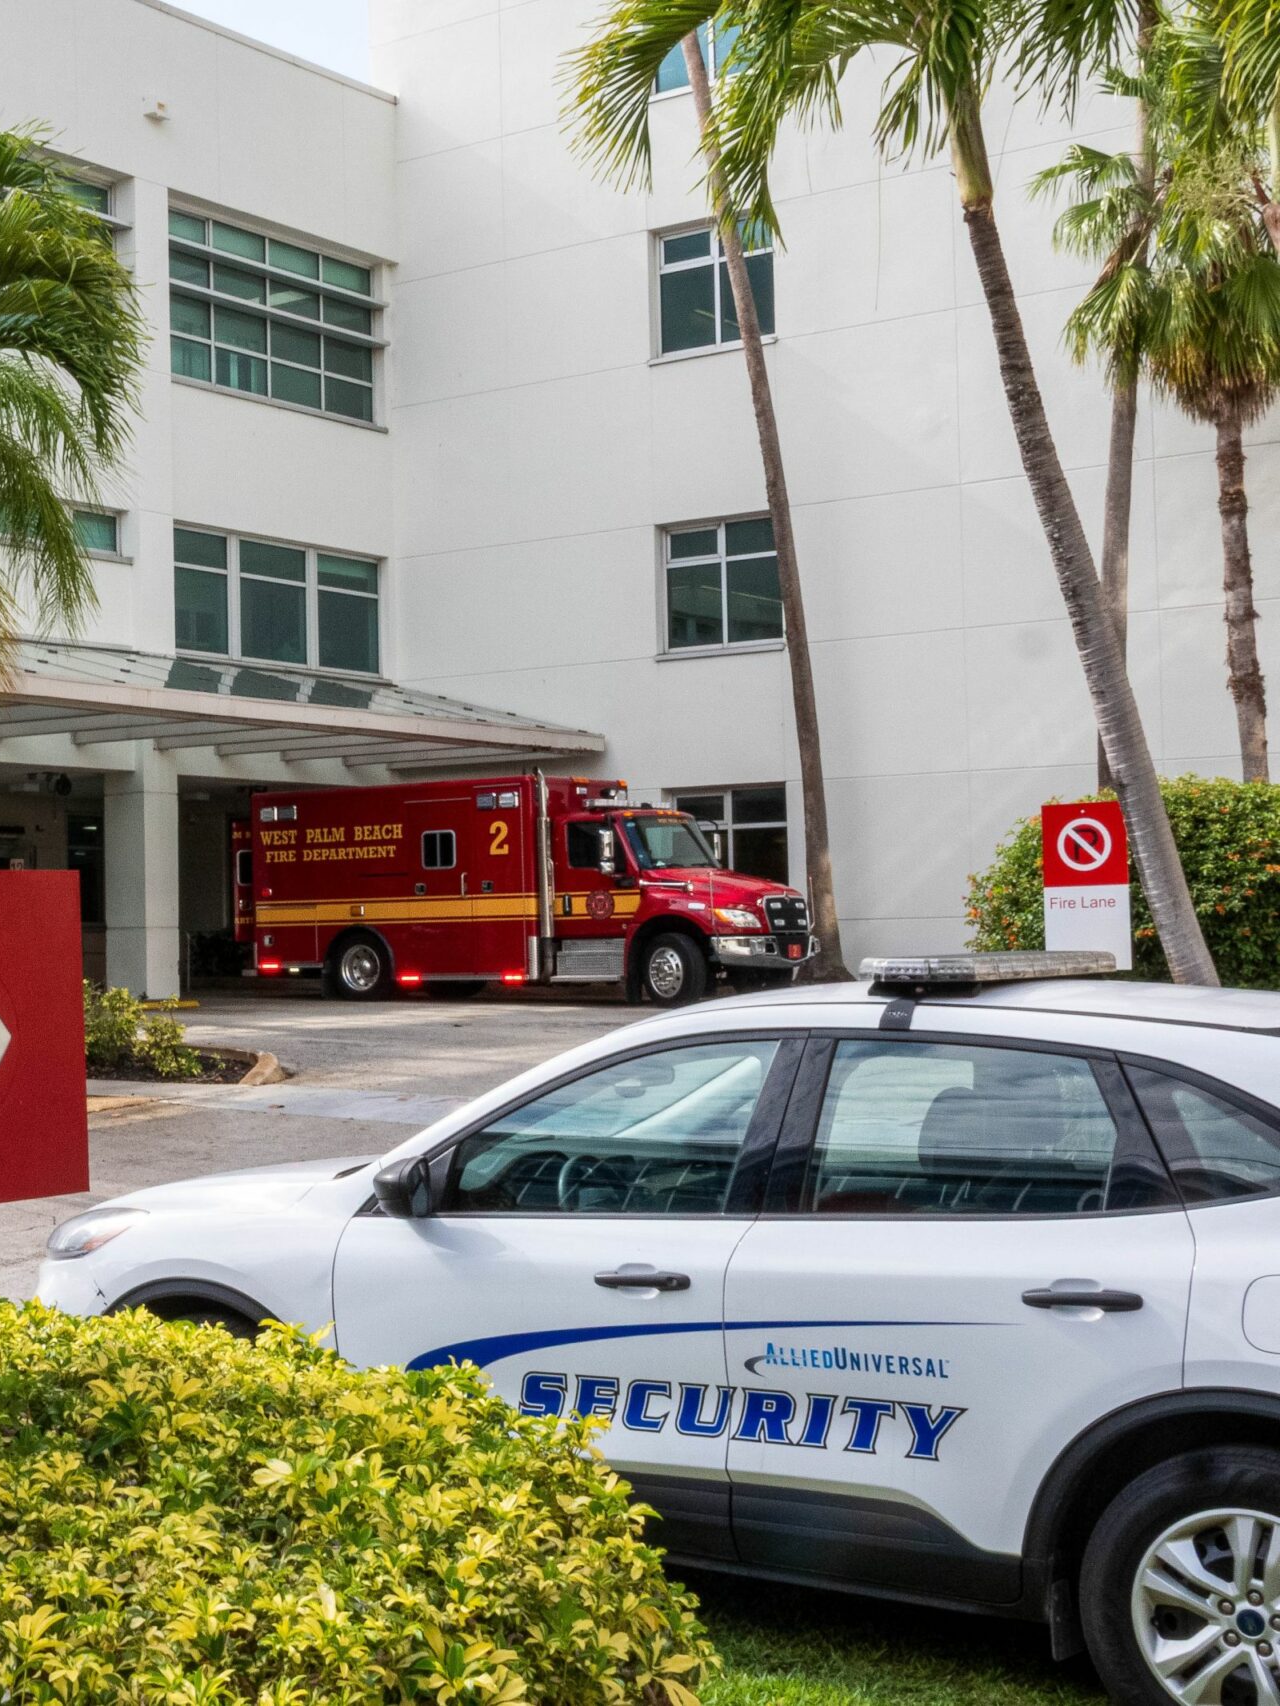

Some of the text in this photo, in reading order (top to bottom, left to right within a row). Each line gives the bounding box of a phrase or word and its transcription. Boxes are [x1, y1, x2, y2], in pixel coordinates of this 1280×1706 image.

[260, 830, 298, 847] WEST
[305, 827, 345, 845] PALM
[354, 824, 404, 842] BEACH
[489, 821, 509, 856] 2
[265, 845, 397, 864] FIRE DEPARTMENT
[1050, 896, 1116, 910] Fire Lane
[520, 1371, 968, 1461] SECURITY
